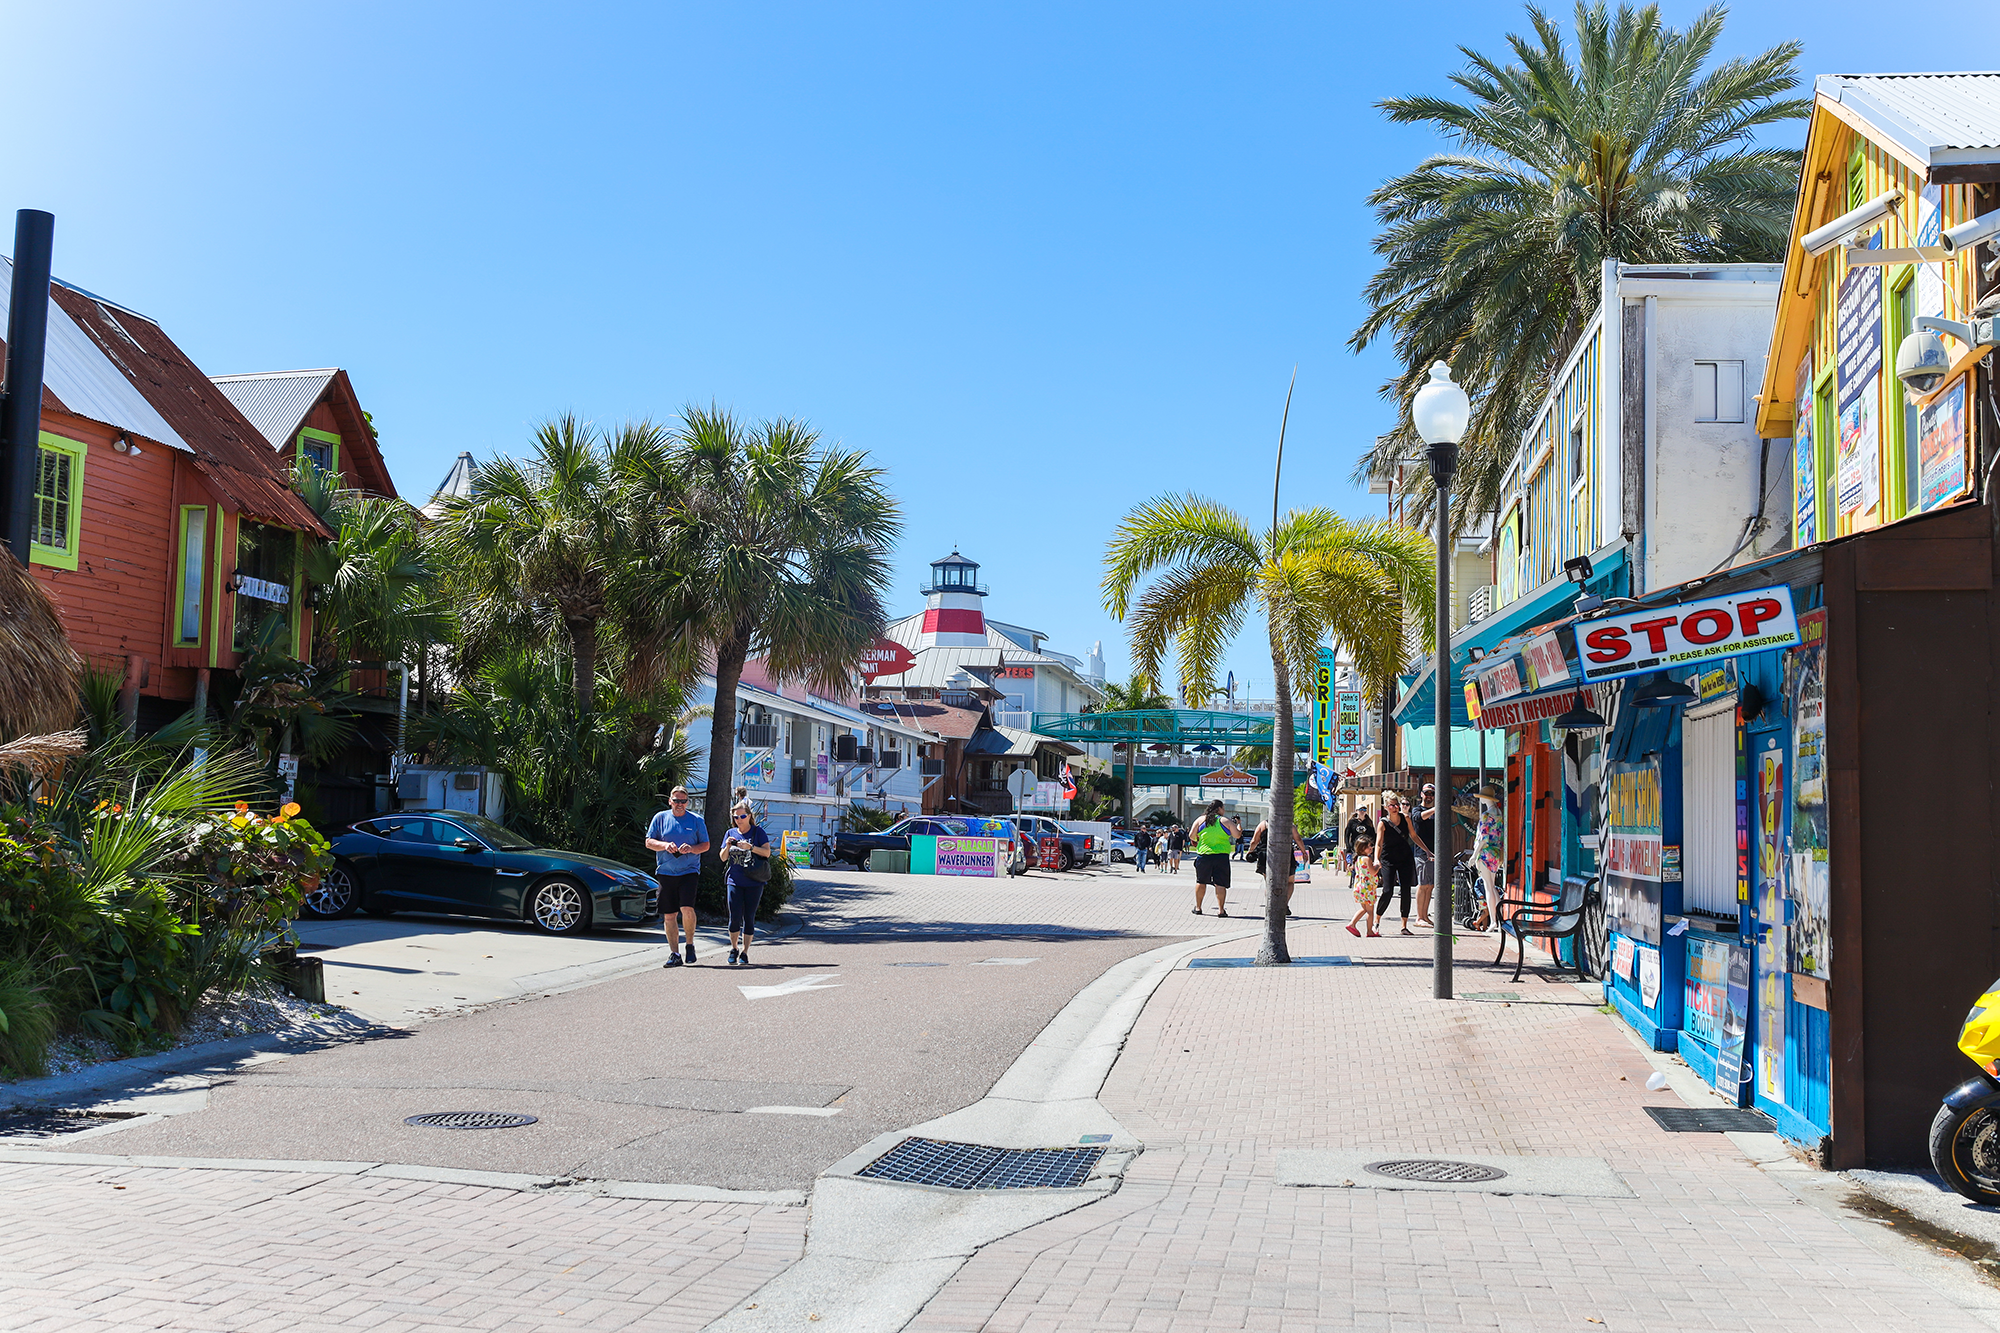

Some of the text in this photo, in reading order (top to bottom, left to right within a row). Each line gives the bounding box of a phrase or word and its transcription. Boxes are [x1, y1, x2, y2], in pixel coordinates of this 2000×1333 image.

[1586, 598, 1782, 663] STOP
[1669, 632, 1795, 663] PLEASE ASK FOR ASSISTANCE
[1341, 694, 1358, 702] John's
[1343, 703, 1356, 711] Pass
[1340, 712, 1359, 725] GRILLE
[1477, 702, 1519, 730] TOURIST
[1637, 768, 1660, 828] SHOW
[1736, 706, 1748, 901] AIRBRUSH
[938, 854, 994, 867] WAVERUNNERS
[957, 840, 994, 852] PARASAIL
[938, 867, 993, 876] Fishing Charters
[1764, 756, 1776, 1095] PARASAIL
[1690, 955, 1721, 984] DISCOUNT
[1686, 978, 1726, 1020] TICKET
[1691, 1012, 1715, 1041] BOOTH
